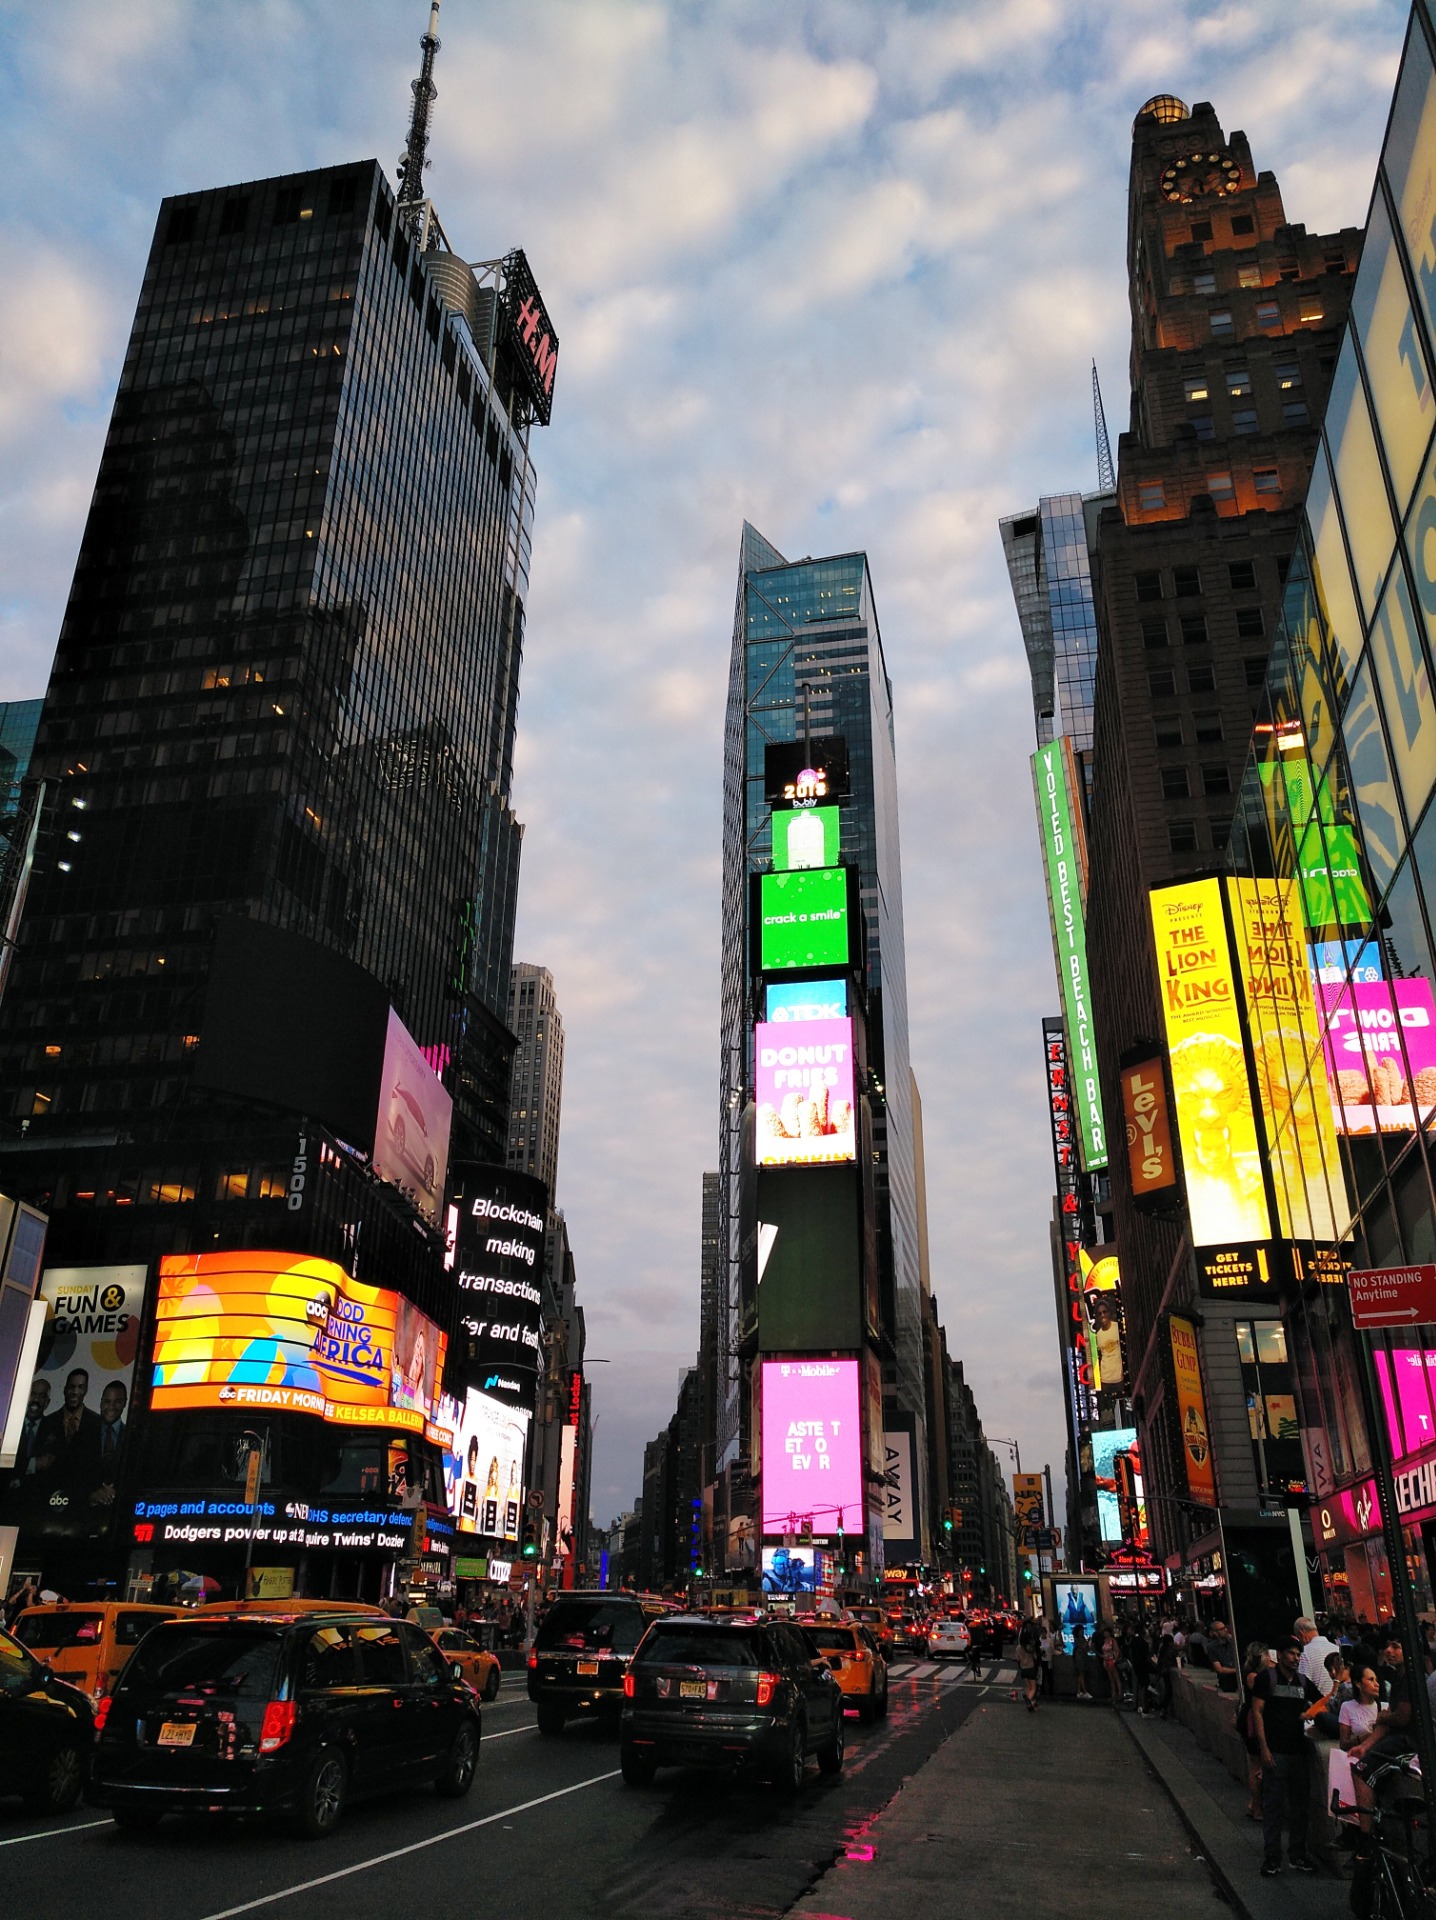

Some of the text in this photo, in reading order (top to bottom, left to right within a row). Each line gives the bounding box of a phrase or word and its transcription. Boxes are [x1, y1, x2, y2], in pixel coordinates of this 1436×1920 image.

[517, 296, 557, 395] H&M
[784, 783, 827, 799] 2018
[764, 912, 796, 925] crack
[799, 914, 807, 922] a
[1169, 926, 1205, 944] THE
[1044, 751, 1064, 855] VOTED
[1057, 861, 1074, 948] BEST
[1069, 955, 1092, 1071] BEACH
[1085, 1078, 1103, 1152] BAR
[1166, 949, 1216, 977] LION
[1166, 978, 1229, 1011] KING
[789, 1002, 841, 1020] TDK
[761, 1044, 848, 1067] DONUT
[774, 1067, 839, 1089] FRIES
[1050, 1043, 1071, 1165] ERNST
[1063, 1193, 1079, 1214] &
[472, 1199, 544, 1233] Blockchain
[485, 1238, 535, 1266] making
[1216, 1252, 1239, 1263] GET
[1205, 1262, 1253, 1275] TICKETS
[458, 1270, 541, 1305] transactions
[1213, 1275, 1249, 1287] HERE!
[1353, 1271, 1422, 1288] NO STANDING
[57, 1285, 94, 1295] SUNDAY
[1356, 1289, 1398, 1302] Anytime
[54, 1285, 122, 1315] FUN &
[52, 1314, 130, 1335] GAMES
[490, 1324, 519, 1342] and
[1172, 1325, 1196, 1351] BUBBA
[1177, 1351, 1197, 1372] GUMP
[237, 1389, 290, 1404] FRIDAY
[336, 1406, 384, 1422] KELSEA
[885, 1446, 903, 1525] AWAY
[146, 1503, 178, 1517] pages
[180, 1501, 205, 1514] and
[331, 1510, 387, 1526] secretary
[164, 1525, 221, 1541] Dodgers
[377, 1533, 405, 1548] Dozier
